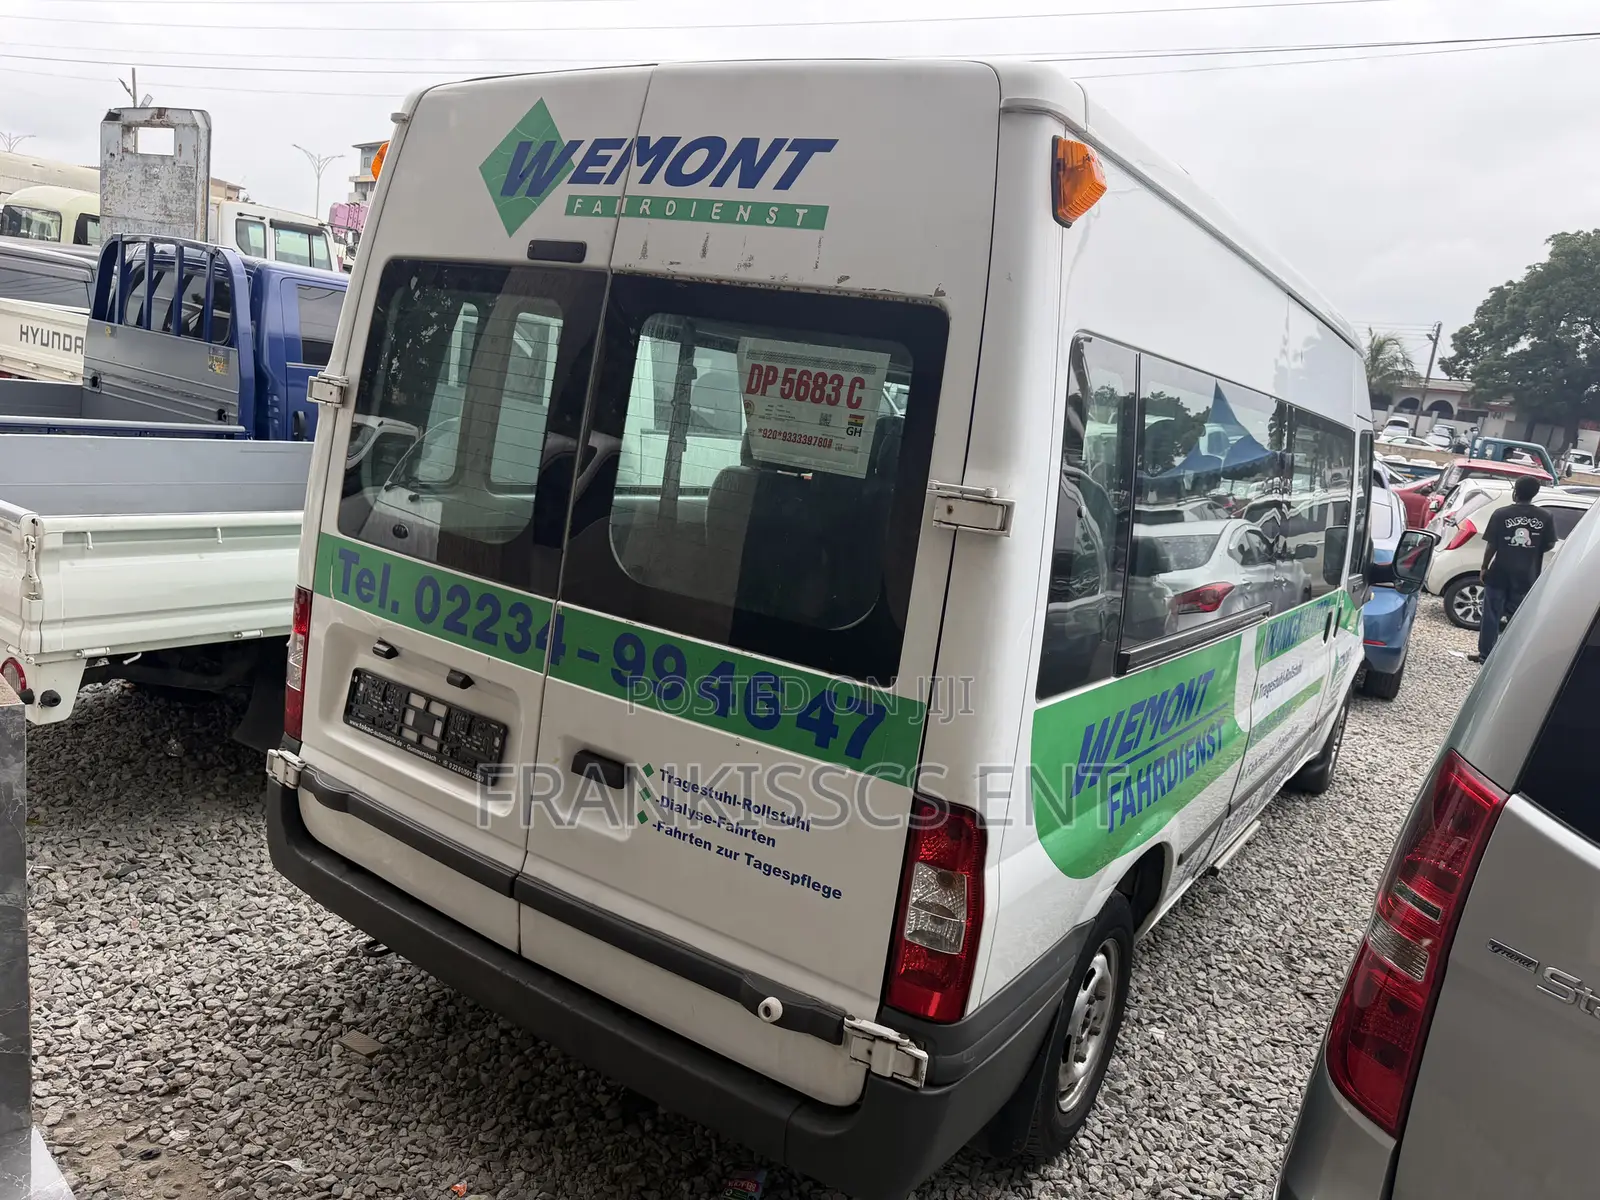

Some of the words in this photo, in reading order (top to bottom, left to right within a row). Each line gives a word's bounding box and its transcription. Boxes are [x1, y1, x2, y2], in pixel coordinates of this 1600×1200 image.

[500, 135, 840, 198] WEMONT
[572, 198, 810, 227] FAHRDIENST
[20, 324, 84, 355] HYUNDA
[745, 363, 779, 396] DP
[780, 367, 844, 407] 5683
[846, 376, 866, 410] C
[846, 426, 862, 437] GH
[337, 547, 400, 615] Tel.
[1070, 668, 1216, 799] WEMONT
[659, 768, 811, 832] Tragestuhl-Rollstuhl
[1108, 718, 1225, 834] FAHRDIENST
[715, 844, 741, 862] zur
[744, 852, 843, 900] Tagespflege
